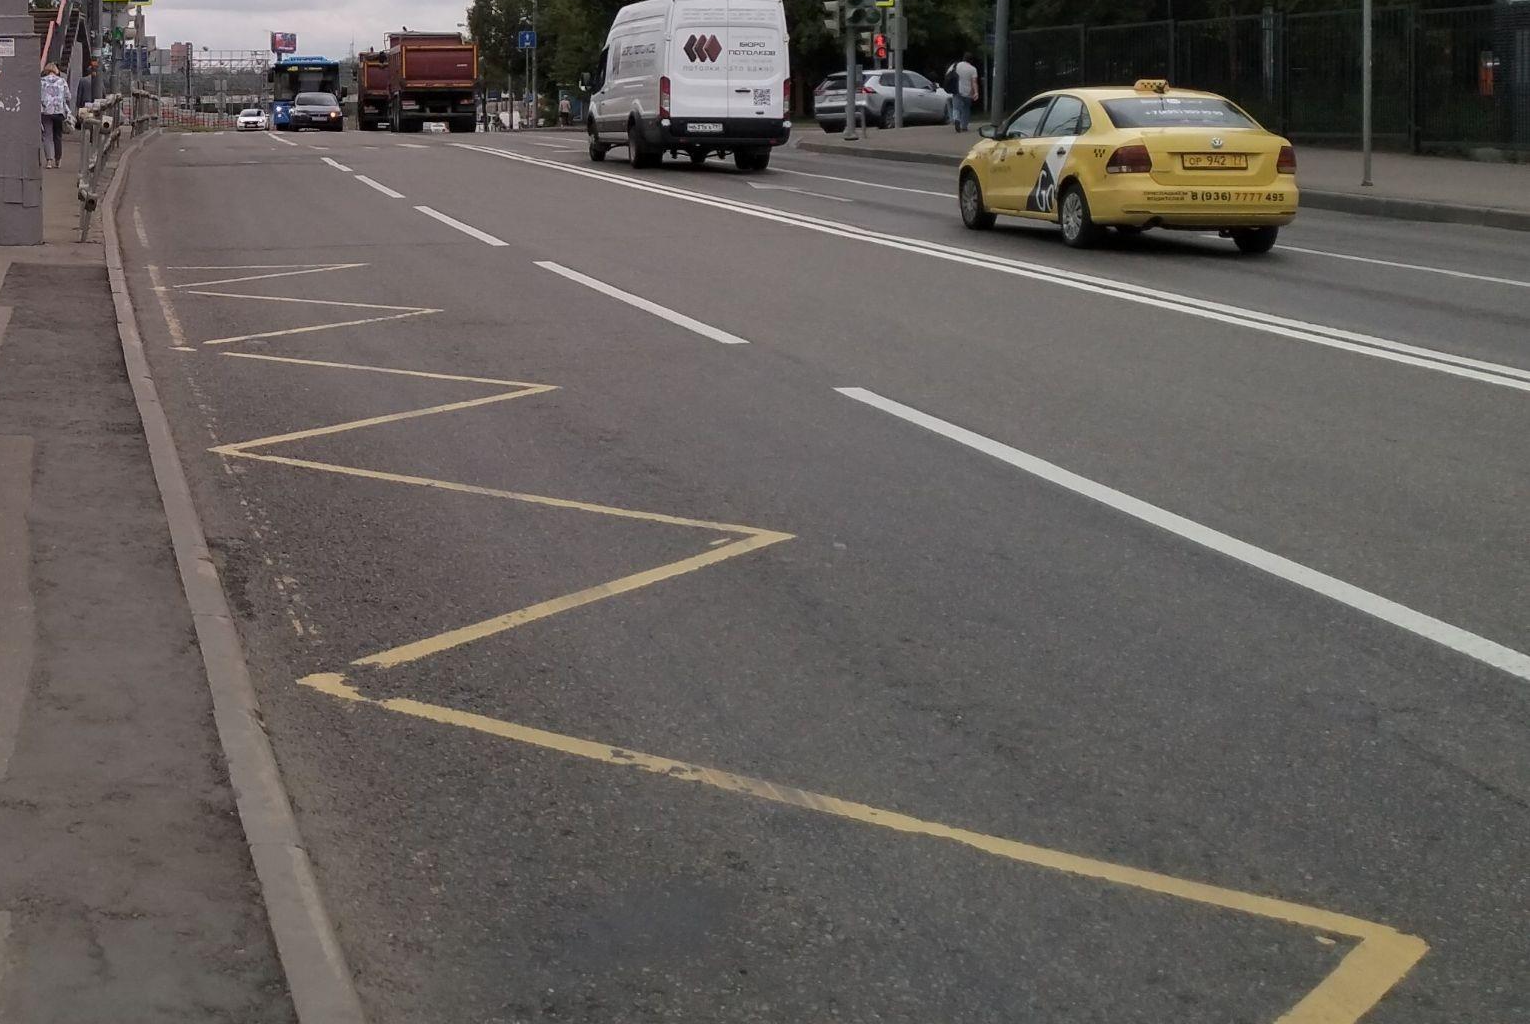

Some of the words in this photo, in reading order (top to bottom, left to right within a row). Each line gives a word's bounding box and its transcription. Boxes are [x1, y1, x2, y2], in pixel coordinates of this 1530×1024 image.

[1206, 156, 1226, 166] 942
[1191, 191, 1198, 200] 8
[1201, 191, 1231, 201] (936)
[1234, 192, 1263, 201] 7777
[1265, 193, 1285, 202] 495
